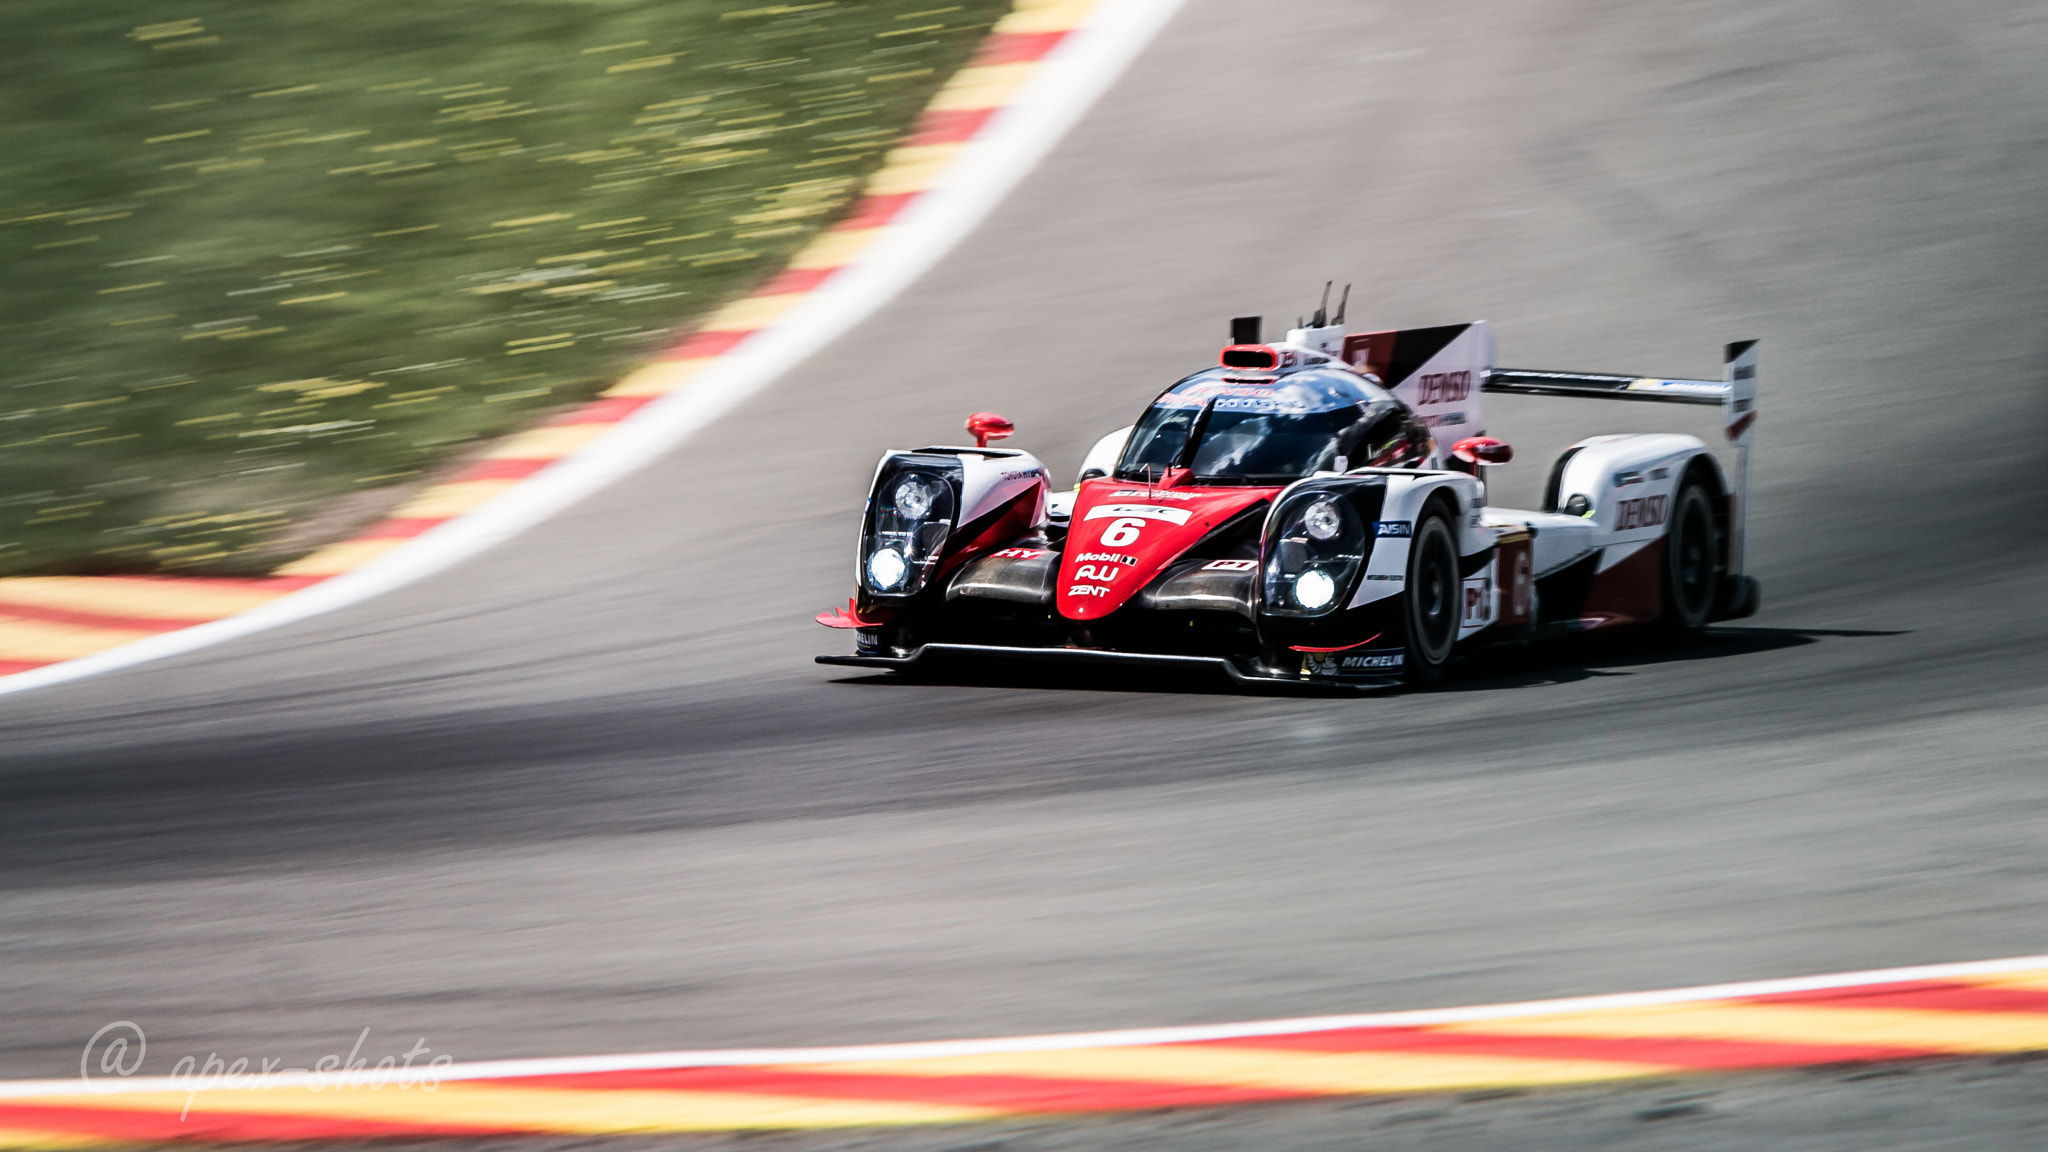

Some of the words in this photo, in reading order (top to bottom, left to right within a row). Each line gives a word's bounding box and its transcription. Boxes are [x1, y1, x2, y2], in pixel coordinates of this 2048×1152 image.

[1614, 494, 1670, 531] DENSO
[1100, 517, 1146, 547] 6
[1377, 523, 1410, 535] AISIN
[993, 549, 1045, 558] HY
[1075, 552, 1120, 563] Mobil
[1068, 585, 1110, 598] ZENT
[1341, 655, 1405, 667] MICHELIN
